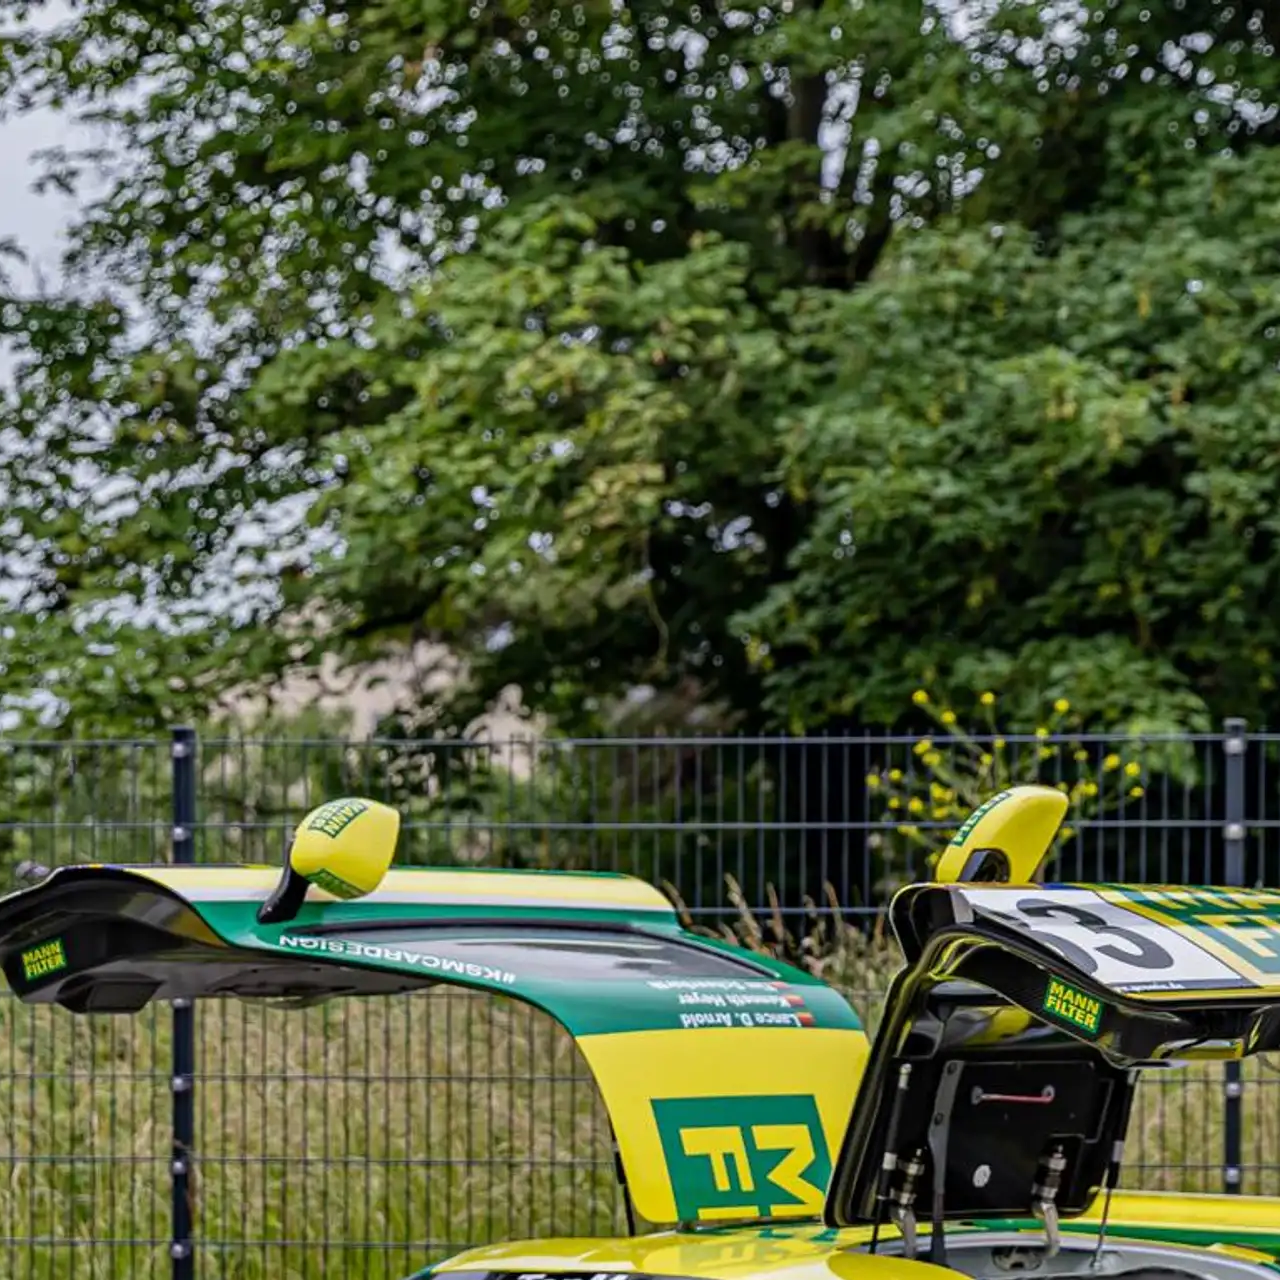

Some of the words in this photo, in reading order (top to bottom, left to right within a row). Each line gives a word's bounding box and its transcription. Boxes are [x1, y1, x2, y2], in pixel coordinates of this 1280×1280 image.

[22, 941, 61, 965] MANN
[1050, 981, 1098, 1014] MANN
[680, 1012, 732, 1028] Arnold
[756, 1013, 802, 1028] Lance
[1047, 996, 1095, 1030] FILTER
